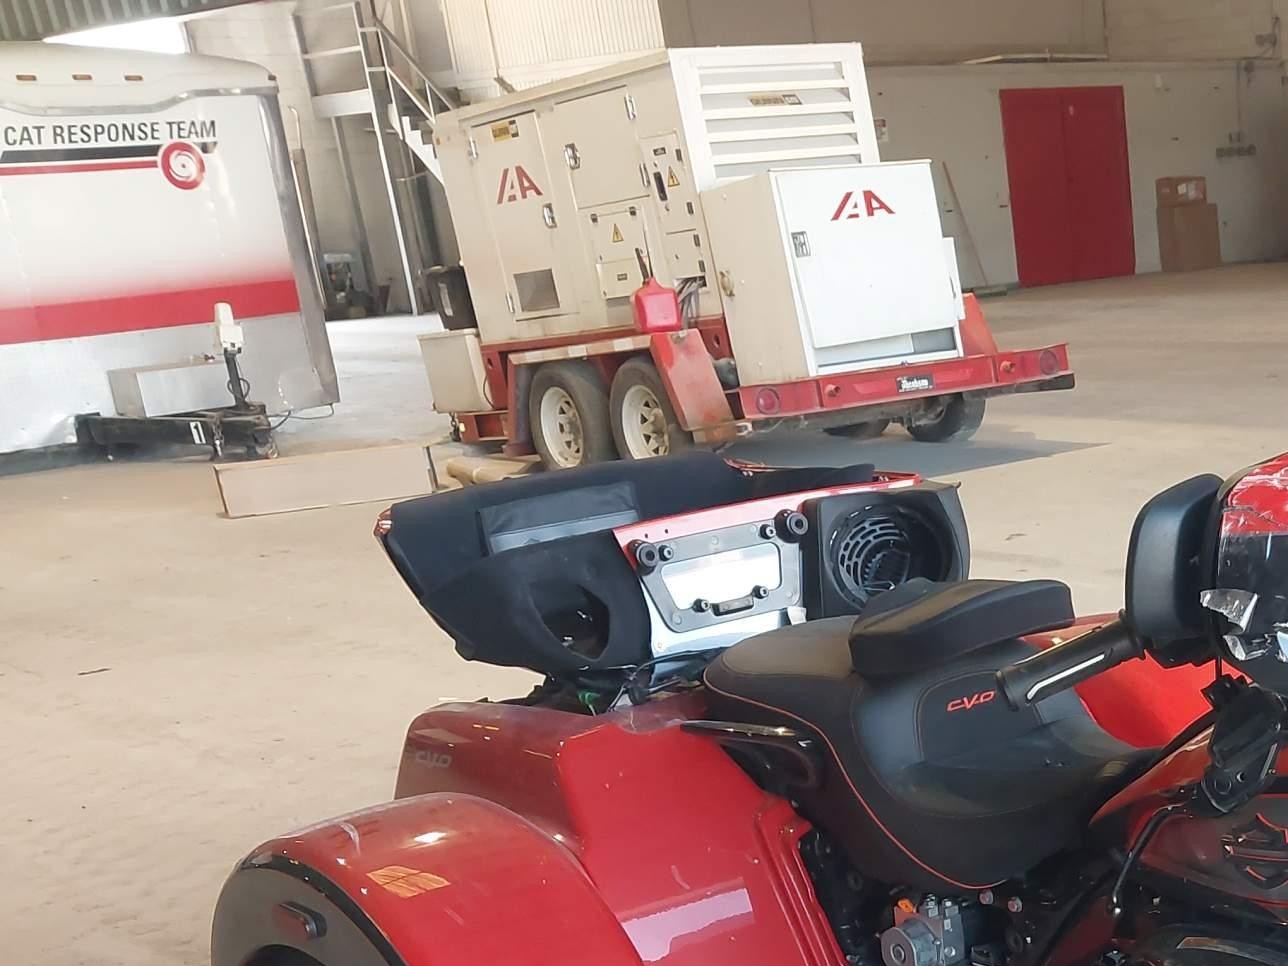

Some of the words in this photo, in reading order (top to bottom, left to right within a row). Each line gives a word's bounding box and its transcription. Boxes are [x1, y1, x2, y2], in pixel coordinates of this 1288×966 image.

[4, 125, 45, 146] CAT
[52, 121, 160, 144] RESPONSE
[166, 120, 217, 140] TEAM
[946, 690, 995, 711] CVO
